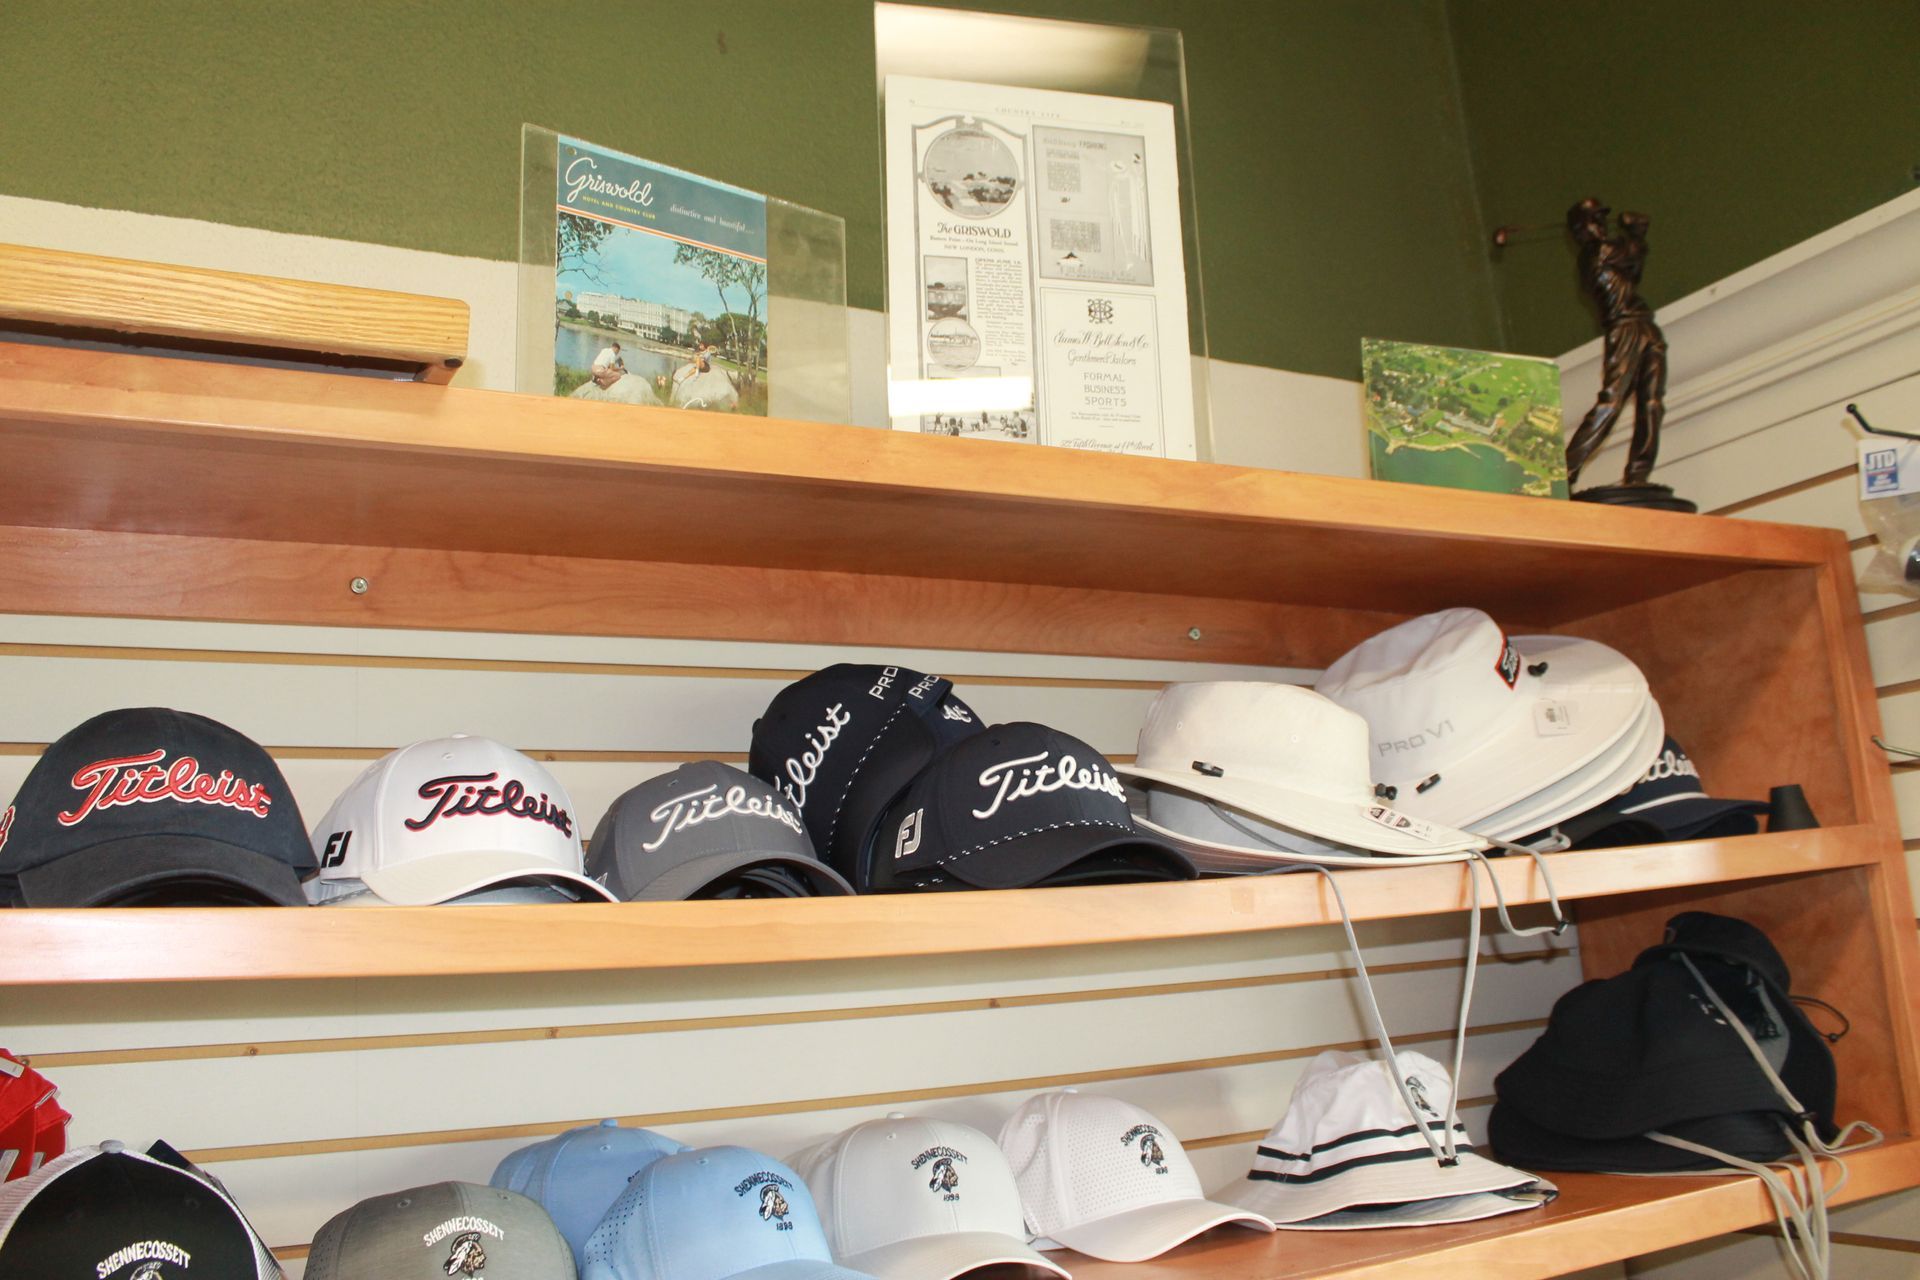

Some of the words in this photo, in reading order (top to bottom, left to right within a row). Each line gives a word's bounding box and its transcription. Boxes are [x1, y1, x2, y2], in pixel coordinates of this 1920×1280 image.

[565, 156, 654, 207] Griswold
[937, 222, 953, 234] The
[953, 225, 1011, 238] GRISWOLD
[1083, 372, 1125, 383] FORMAL
[1083, 384, 1127, 395] BUSINESS
[1084, 396, 1128, 407] SPORTS
[868, 666, 899, 700] PRO
[908, 674, 940, 700] PRO
[1377, 734, 1426, 757] PRO
[1425, 719, 1454, 739] V1
[57, 748, 272, 827] Titleist
[972, 751, 1127, 819] Titleist
[404, 771, 573, 839] Titleist
[642, 784, 803, 852] Titleist
[320, 830, 353, 869] FJ
[894, 808, 924, 859] FJ
[423, 1215, 505, 1247] SHENNECOSSETT
[96, 1240, 191, 1280] SHENNECOSSETT
